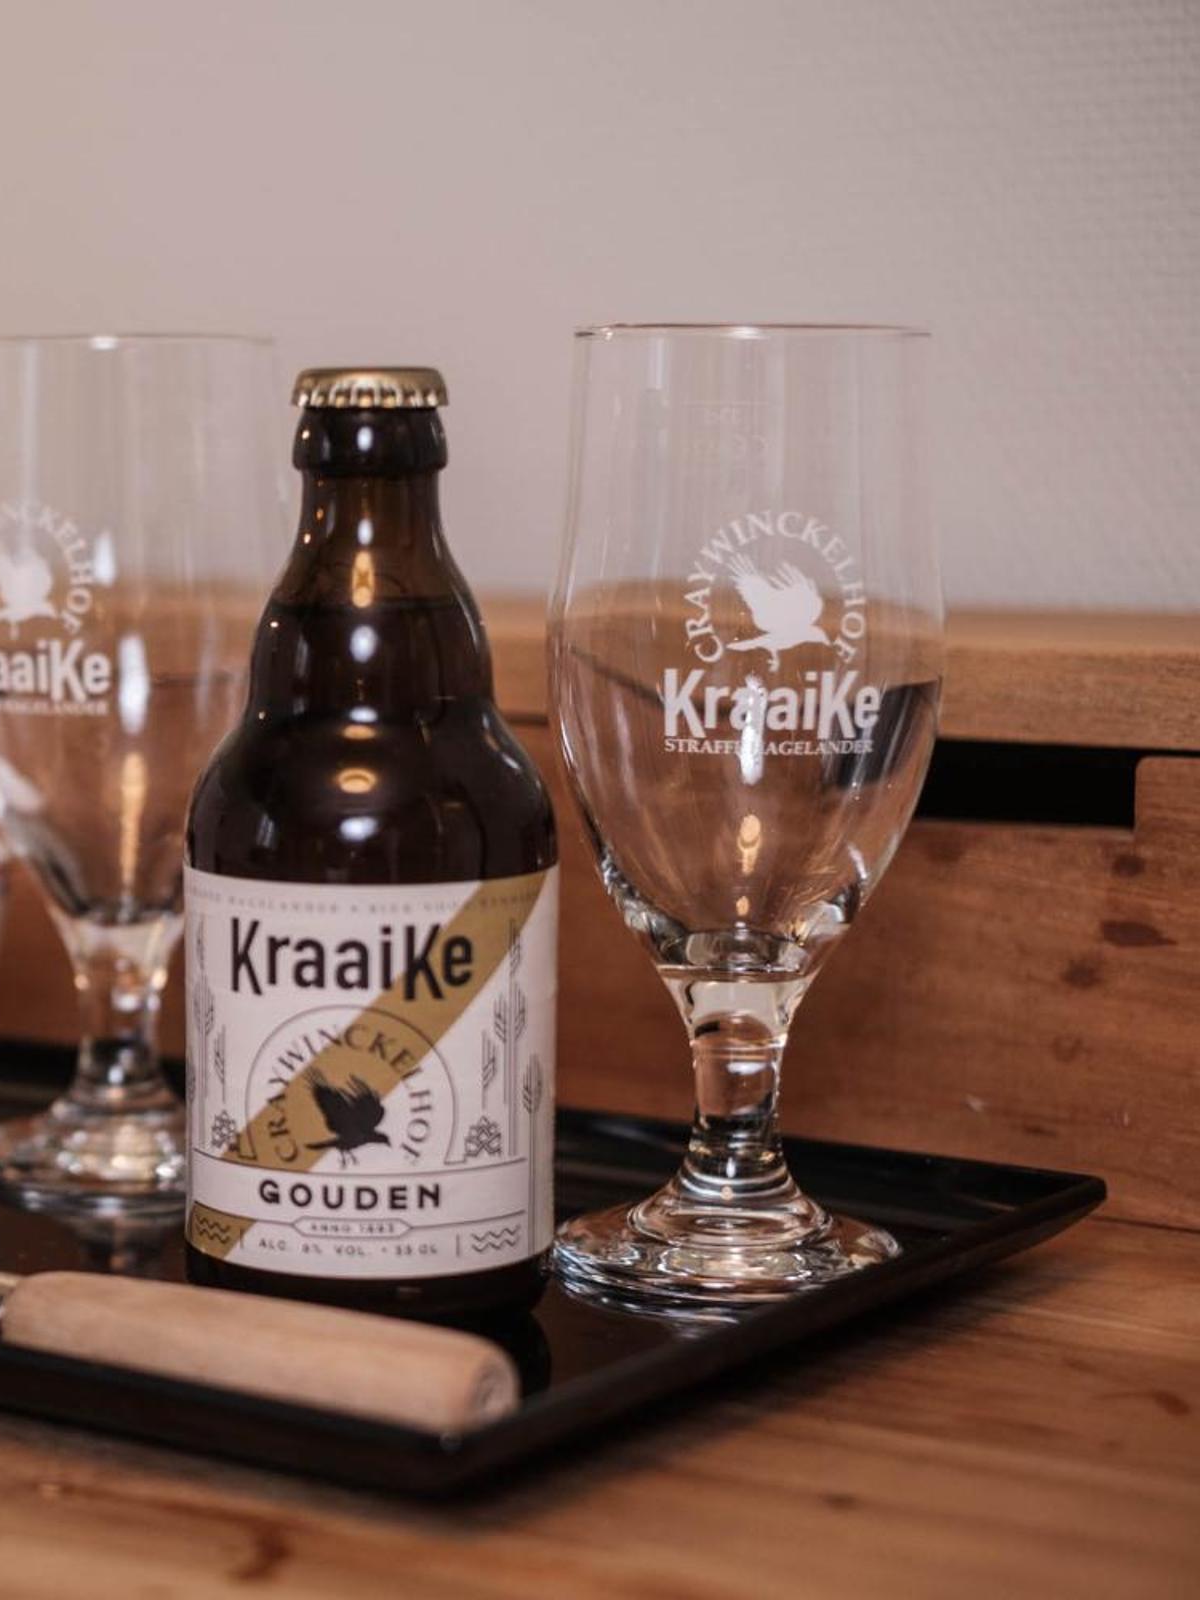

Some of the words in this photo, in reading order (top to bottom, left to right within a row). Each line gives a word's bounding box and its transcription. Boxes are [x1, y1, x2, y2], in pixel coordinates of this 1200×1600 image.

[683, 509, 867, 664] CRAYWINCKELHOF
[663, 668, 882, 739] KraaiKe
[230, 917, 473, 1000] KraaiKe
[266, 1021, 434, 1168] CRAYWINCKELHOF
[258, 1178, 443, 1211] GOUDEN
